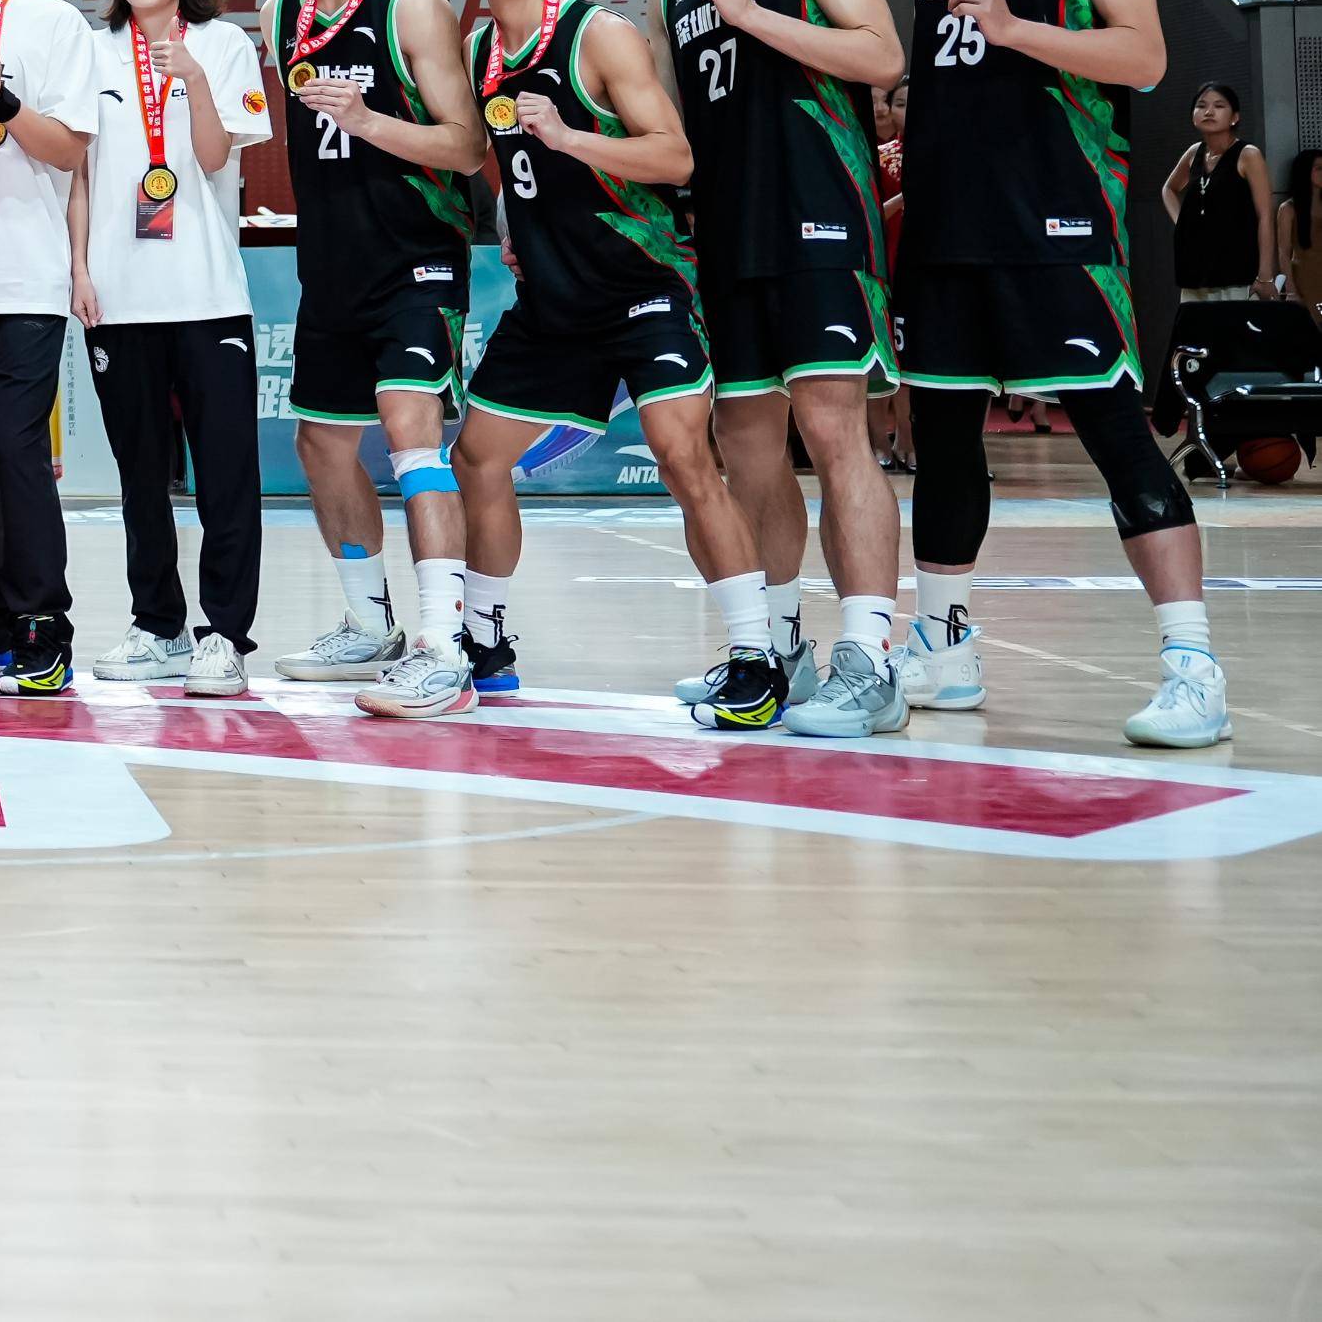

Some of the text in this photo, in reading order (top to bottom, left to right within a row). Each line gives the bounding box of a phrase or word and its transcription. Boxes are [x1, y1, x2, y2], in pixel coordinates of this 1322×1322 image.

[934, 13, 986, 67] 25
[698, 37, 737, 103] 27
[315, 110, 351, 159] 21
[511, 149, 538, 199] 9
[616, 465, 660, 485] ANTA
